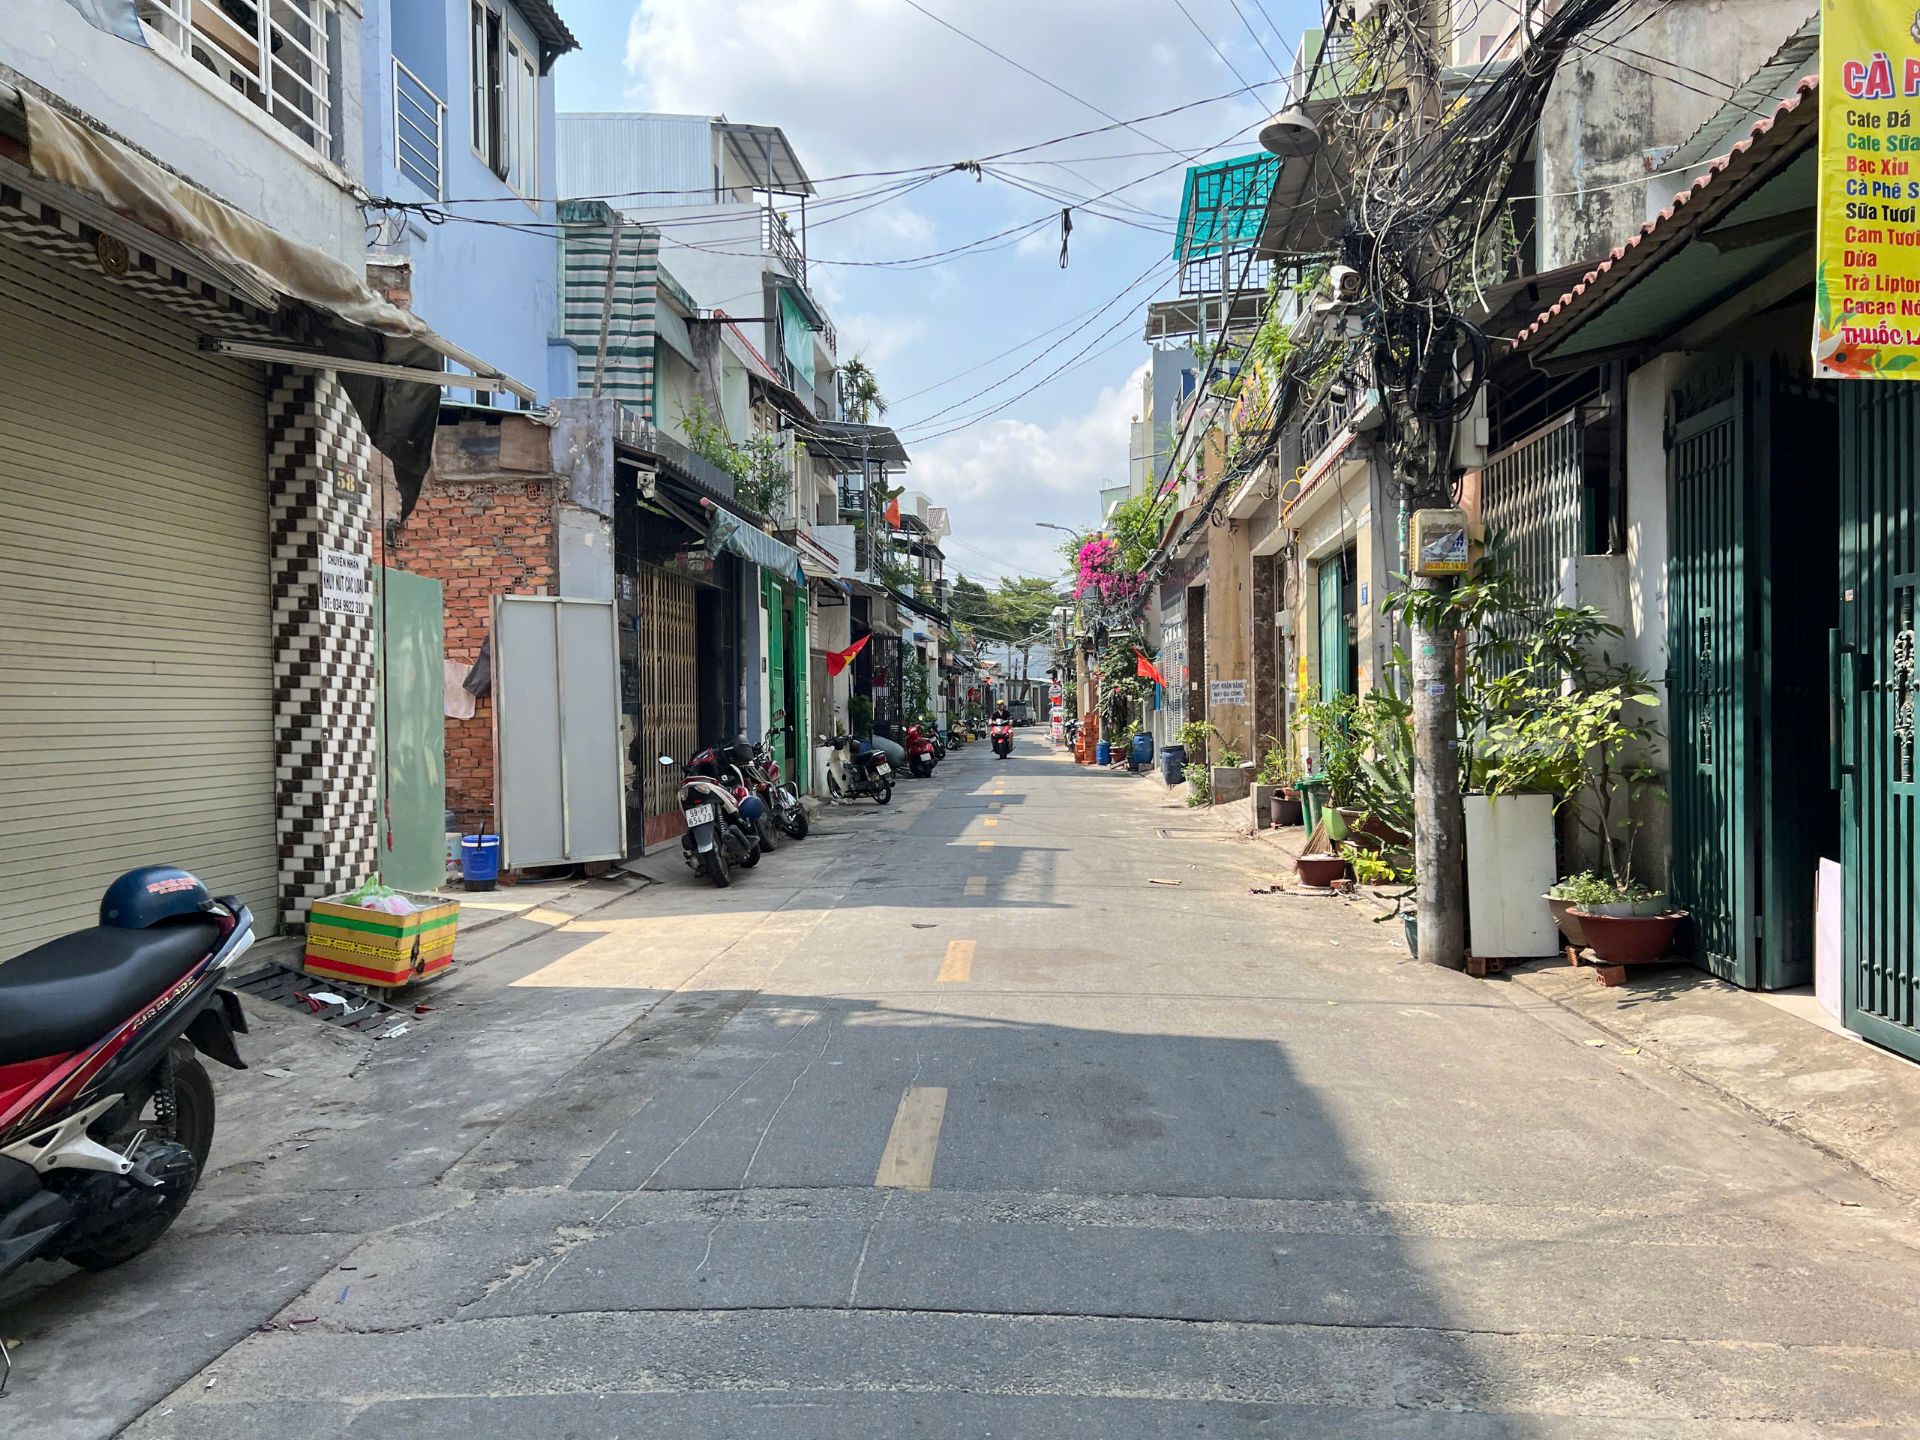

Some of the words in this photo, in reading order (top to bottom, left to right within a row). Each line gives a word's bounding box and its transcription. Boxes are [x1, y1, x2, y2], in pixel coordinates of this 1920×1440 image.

[1843, 52, 1896, 99] CÀ
[1846, 110, 1881, 128] Cafe
[1887, 109, 1911, 128] Đá
[1846, 132, 1881, 152] Cafe
[1886, 134, 1920, 152] Sữa
[1846, 155, 1876, 177] Bạc
[1880, 157, 1909, 176] Xỉu
[1846, 178, 1868, 196] Cà
[1872, 180, 1901, 200] Phê
[1845, 202, 1878, 220] Sữa
[1881, 204, 1916, 223] Tươi
[1845, 226, 1883, 244] Cam
[1887, 228, 1920, 247] Tươi
[1843, 250, 1877, 268] Dừa
[1843, 273, 1870, 292] Trà
[1843, 297, 1897, 316] Cacao
[1841, 320, 1904, 346] THUỐC
[337, 470, 356, 493] 58
[332, 598, 342, 612] 034
[343, 599, 355, 614] 9922
